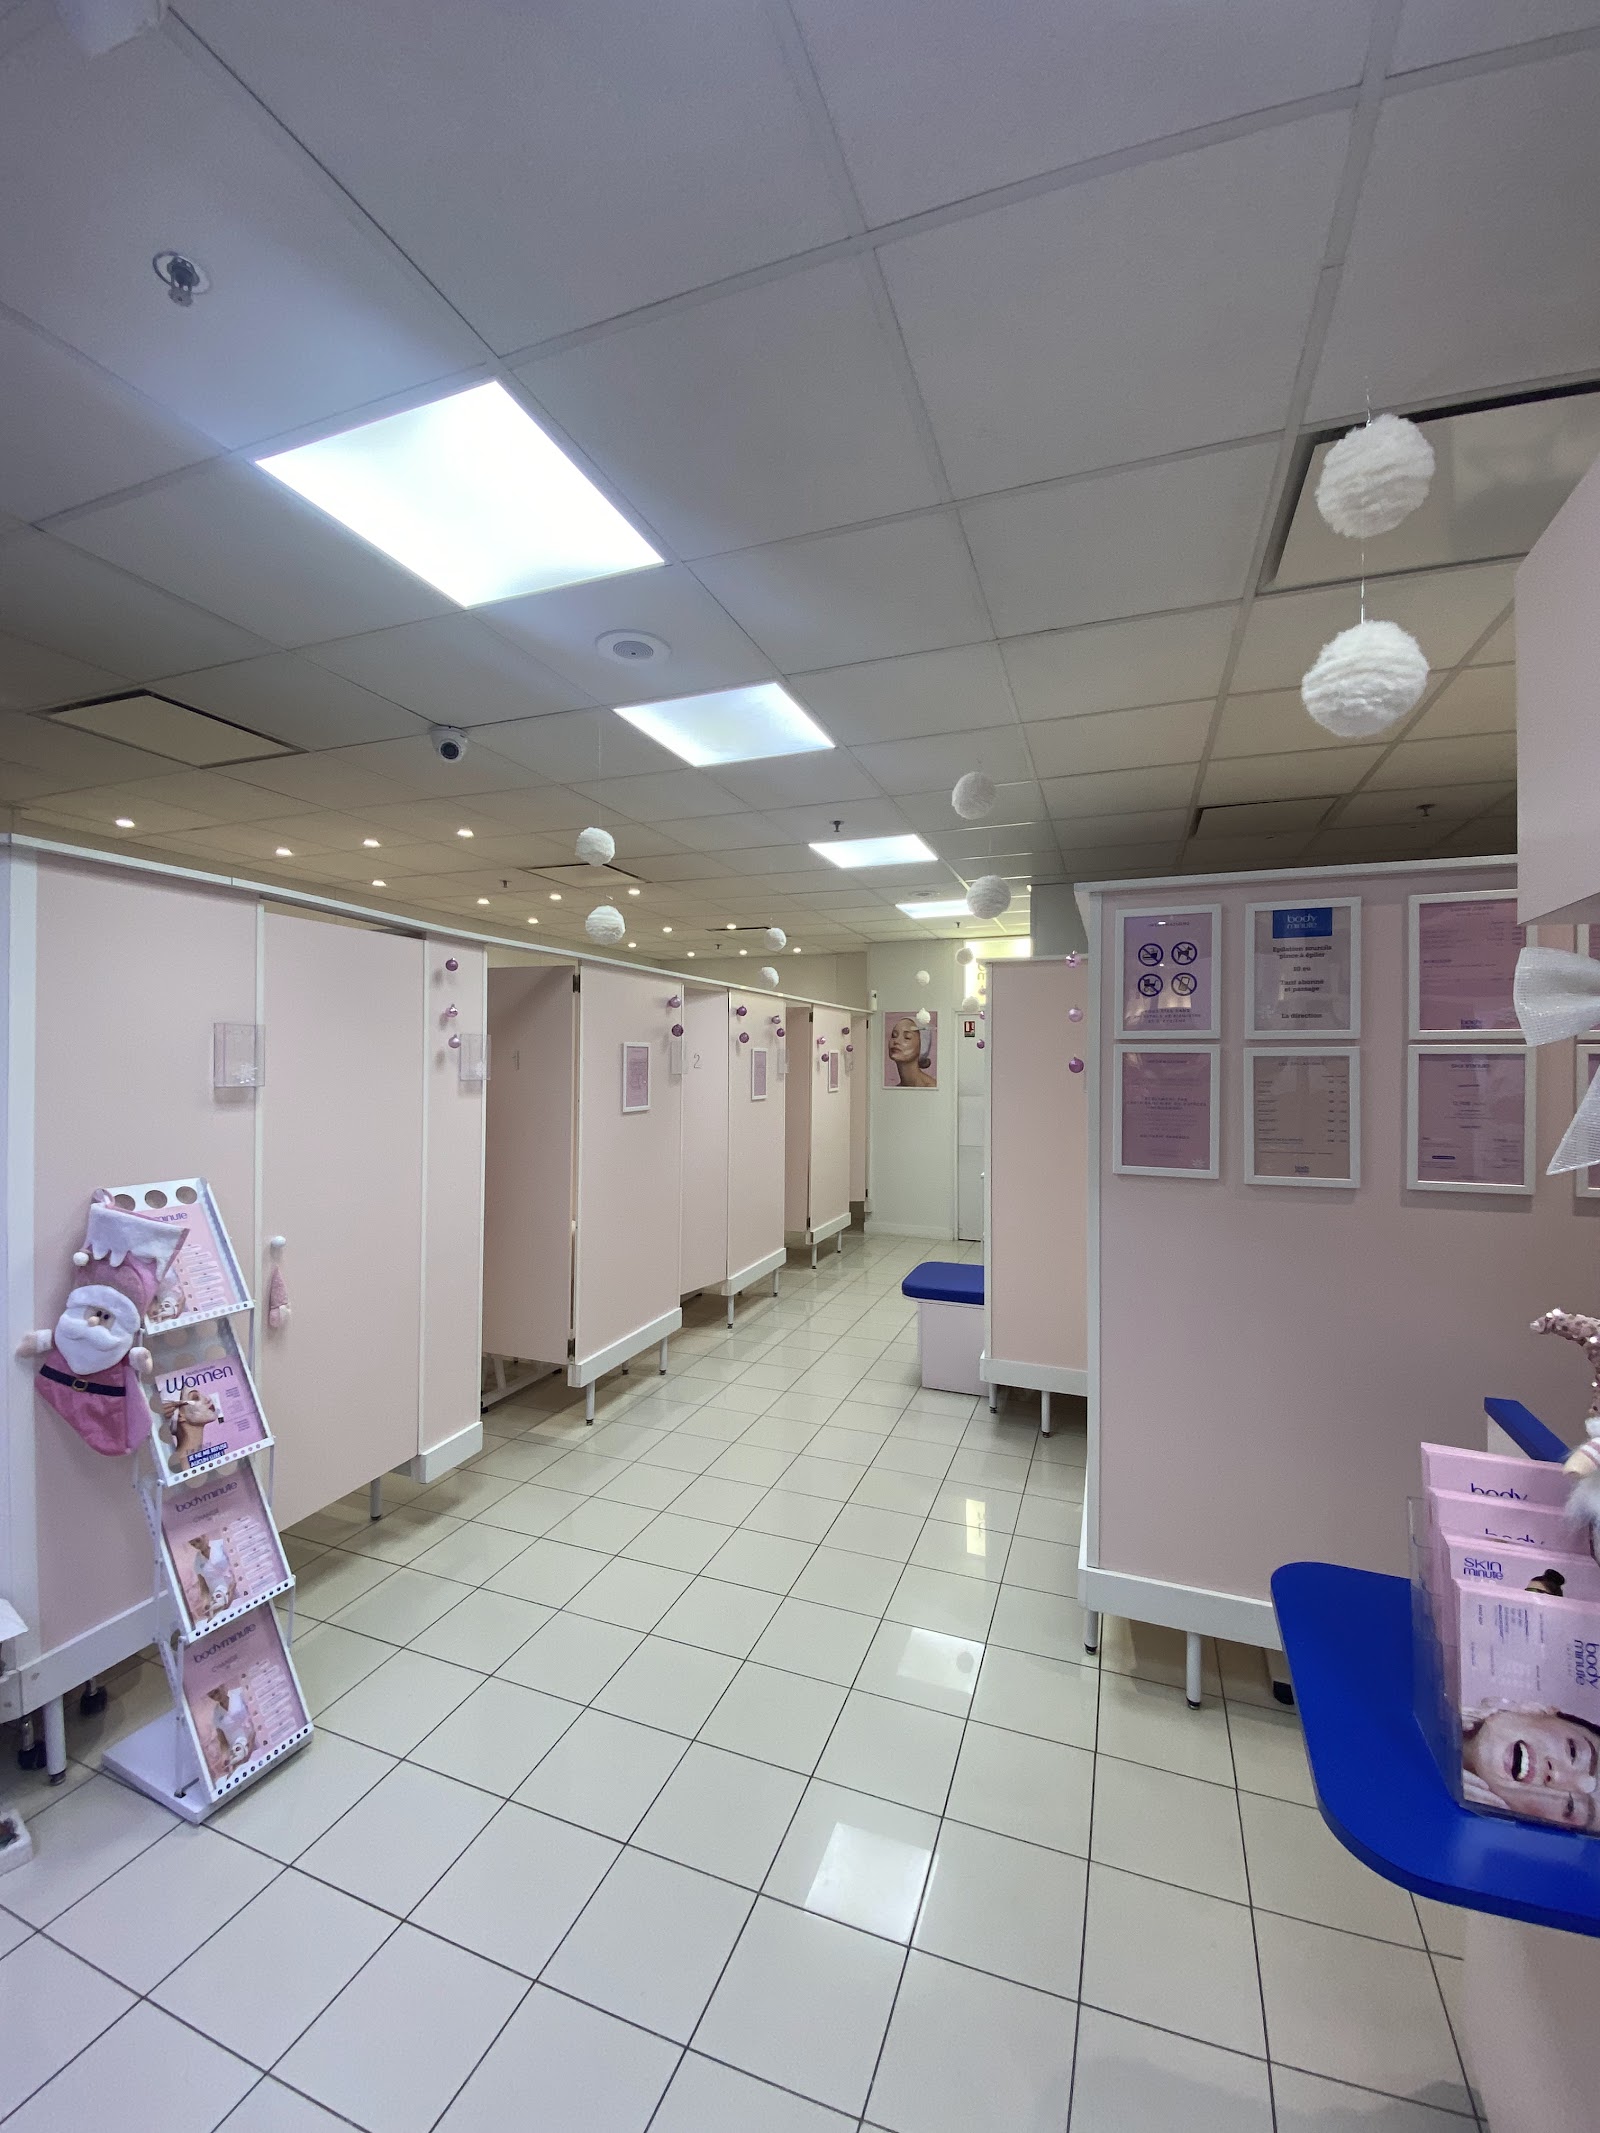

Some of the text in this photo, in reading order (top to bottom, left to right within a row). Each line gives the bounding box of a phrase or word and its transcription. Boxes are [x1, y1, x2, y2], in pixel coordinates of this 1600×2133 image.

[1287, 913, 1318, 923] body
[693, 1053, 701, 1069] 2
[166, 1365, 234, 1394] Women
[1463, 1557, 1502, 1572] SKIN
[1463, 1567, 1504, 1580] minute
[1574, 1639, 1586, 1686] minute
[1585, 1642, 1600, 1690] body
